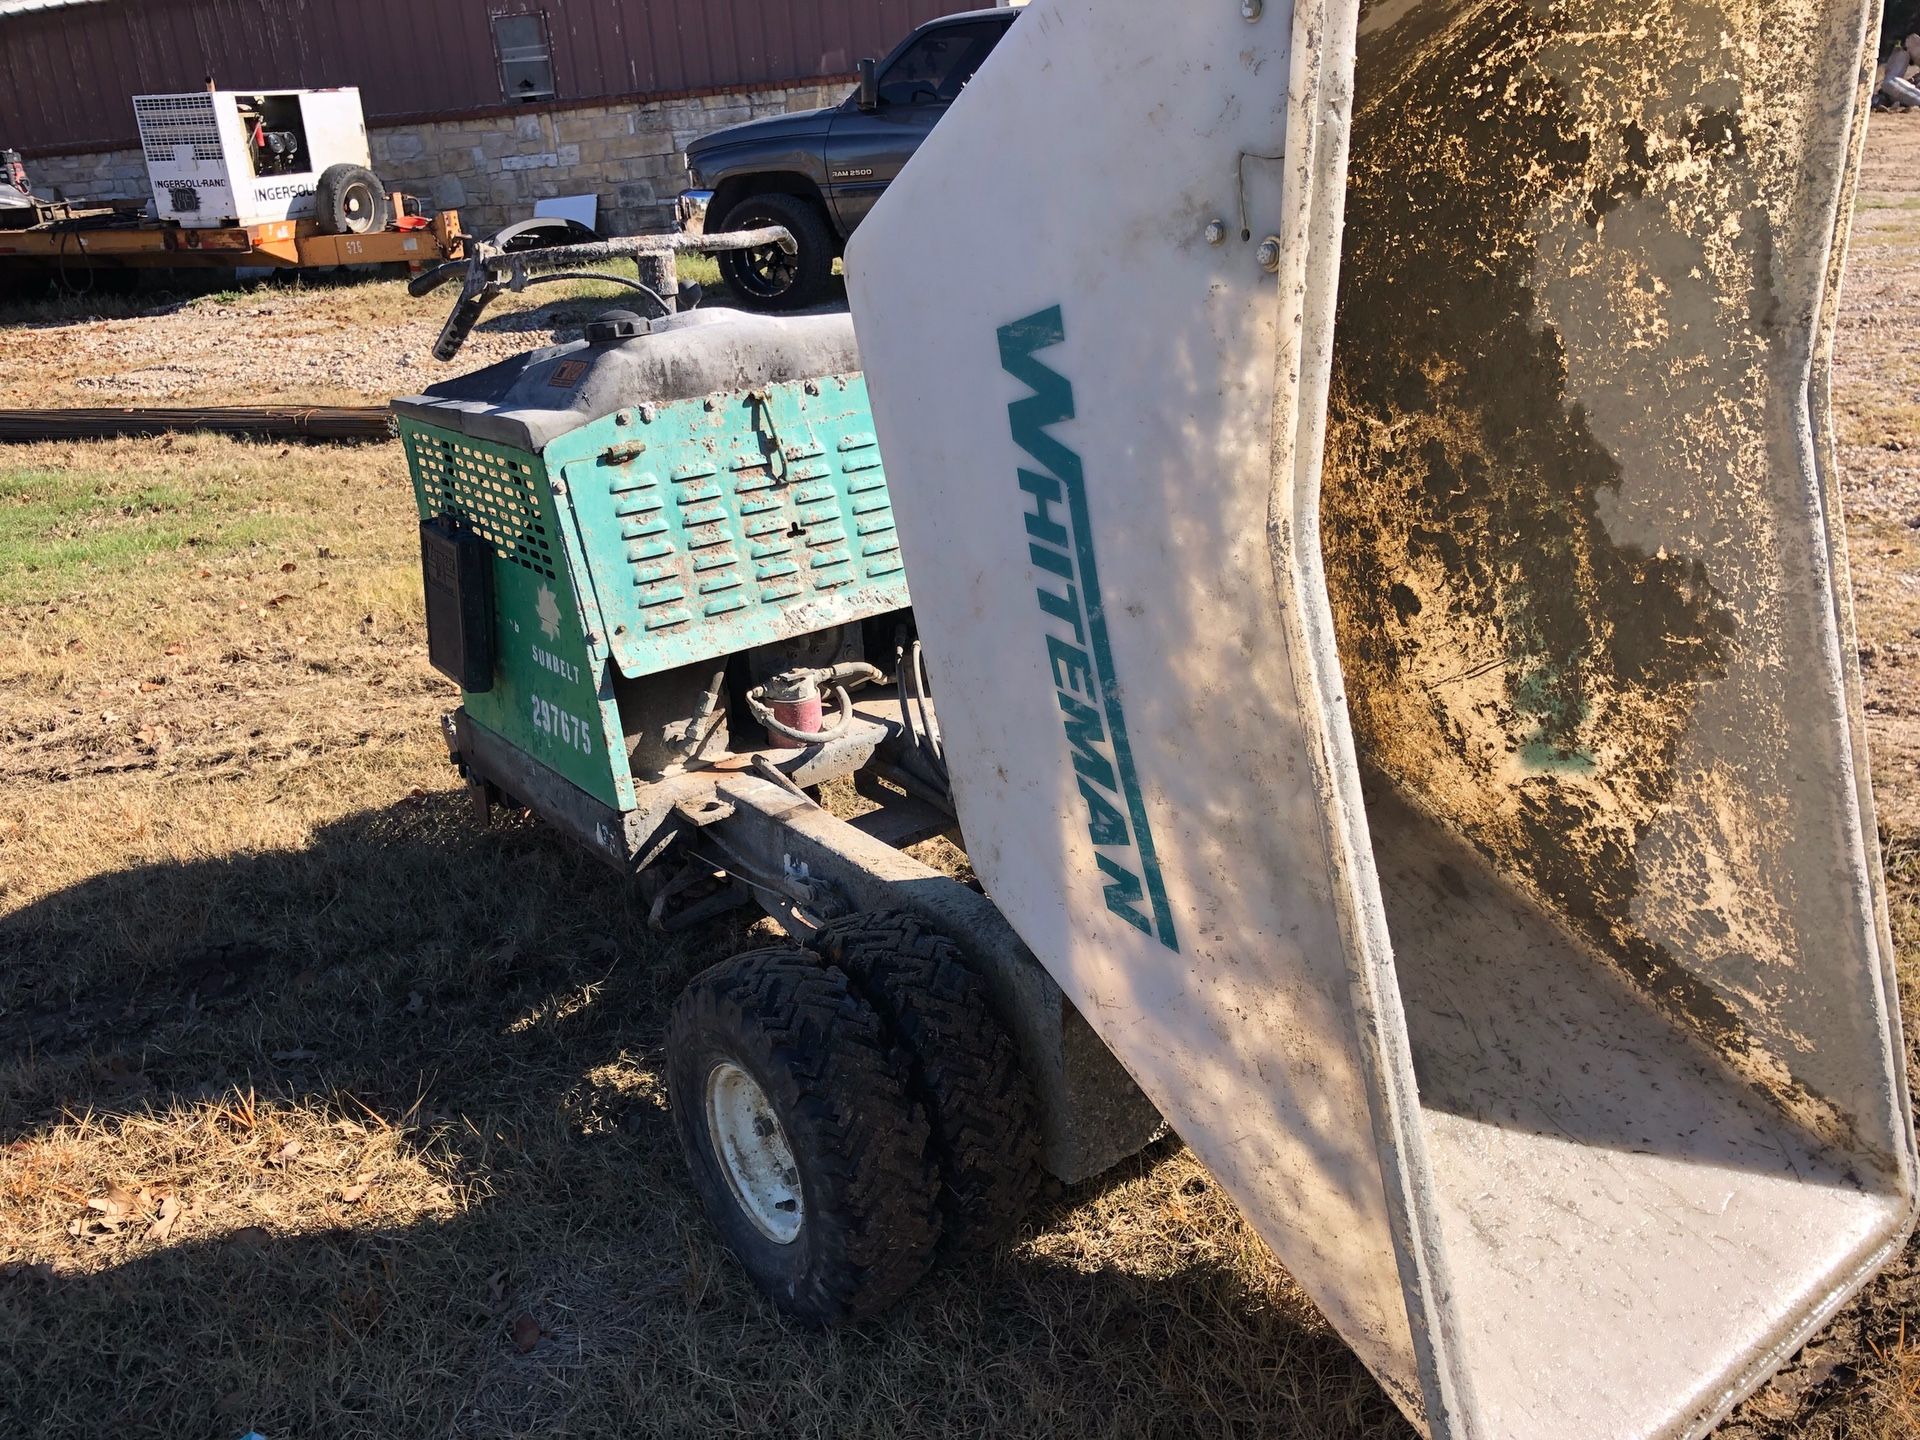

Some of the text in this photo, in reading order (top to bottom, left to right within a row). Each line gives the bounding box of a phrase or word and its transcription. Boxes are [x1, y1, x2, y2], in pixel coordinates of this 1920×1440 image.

[832, 168, 873, 178] RAM 2500
[996, 303, 1180, 954] WHITEMAN
[532, 644, 580, 685] SUNBELT
[531, 694, 592, 756] 297675
